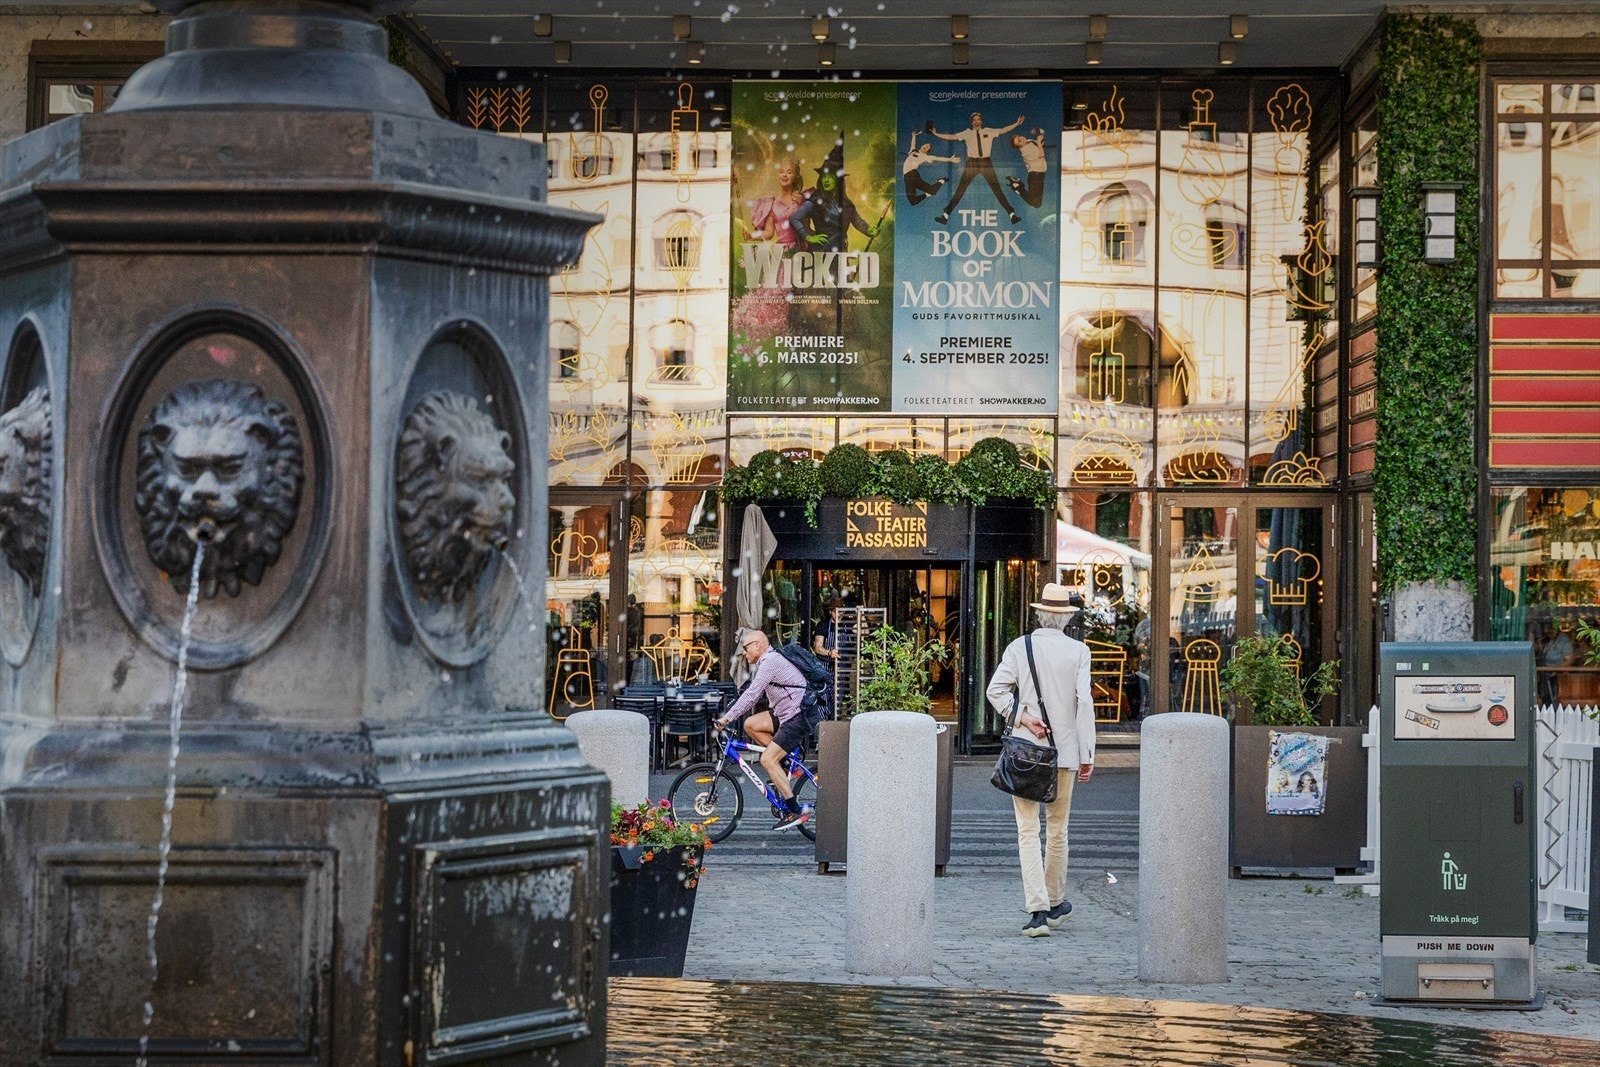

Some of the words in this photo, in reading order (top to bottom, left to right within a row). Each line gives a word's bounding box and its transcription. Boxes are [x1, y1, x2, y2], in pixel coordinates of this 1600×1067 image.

[929, 90, 980, 101] scenekvelder
[981, 91, 1028, 100] presenterer
[958, 209, 998, 227] THE
[930, 230, 1026, 257] BOOK
[962, 260, 992, 278] OF
[900, 281, 1053, 308] MORMON
[944, 313, 1041, 321] FAVORITTMUSIKAL
[774, 336, 844, 348] PREMIERE
[940, 337, 1012, 348] PREMIERE
[760, 352, 773, 364] 6.
[777, 352, 816, 364] MARS
[820, 352, 858, 364] 2025!
[902, 352, 915, 364] 4.
[920, 352, 1005, 364] SEPTEMBER
[1009, 353, 1049, 364] 2025!
[737, 396, 807, 404] FOLKETEATERET
[812, 396, 880, 405] SHOWPAKKER.NO
[904, 397, 974, 405] FOLKETEATERET
[979, 397, 1046, 405] SHOWPAKKER.NO
[847, 501, 892, 516] FOLKE
[876, 517, 927, 532] TEATER
[846, 532, 927, 547] PASSASJEN
[1551, 541, 1600, 560] HA
[1429, 914, 1449, 923] Tråkk
[1450, 914, 1460, 924] på
[1460, 915, 1479, 925] meg!
[1417, 942, 1442, 950] PUSH
[1447, 943, 1461, 951] ME
[1466, 943, 1495, 951] DOWN
